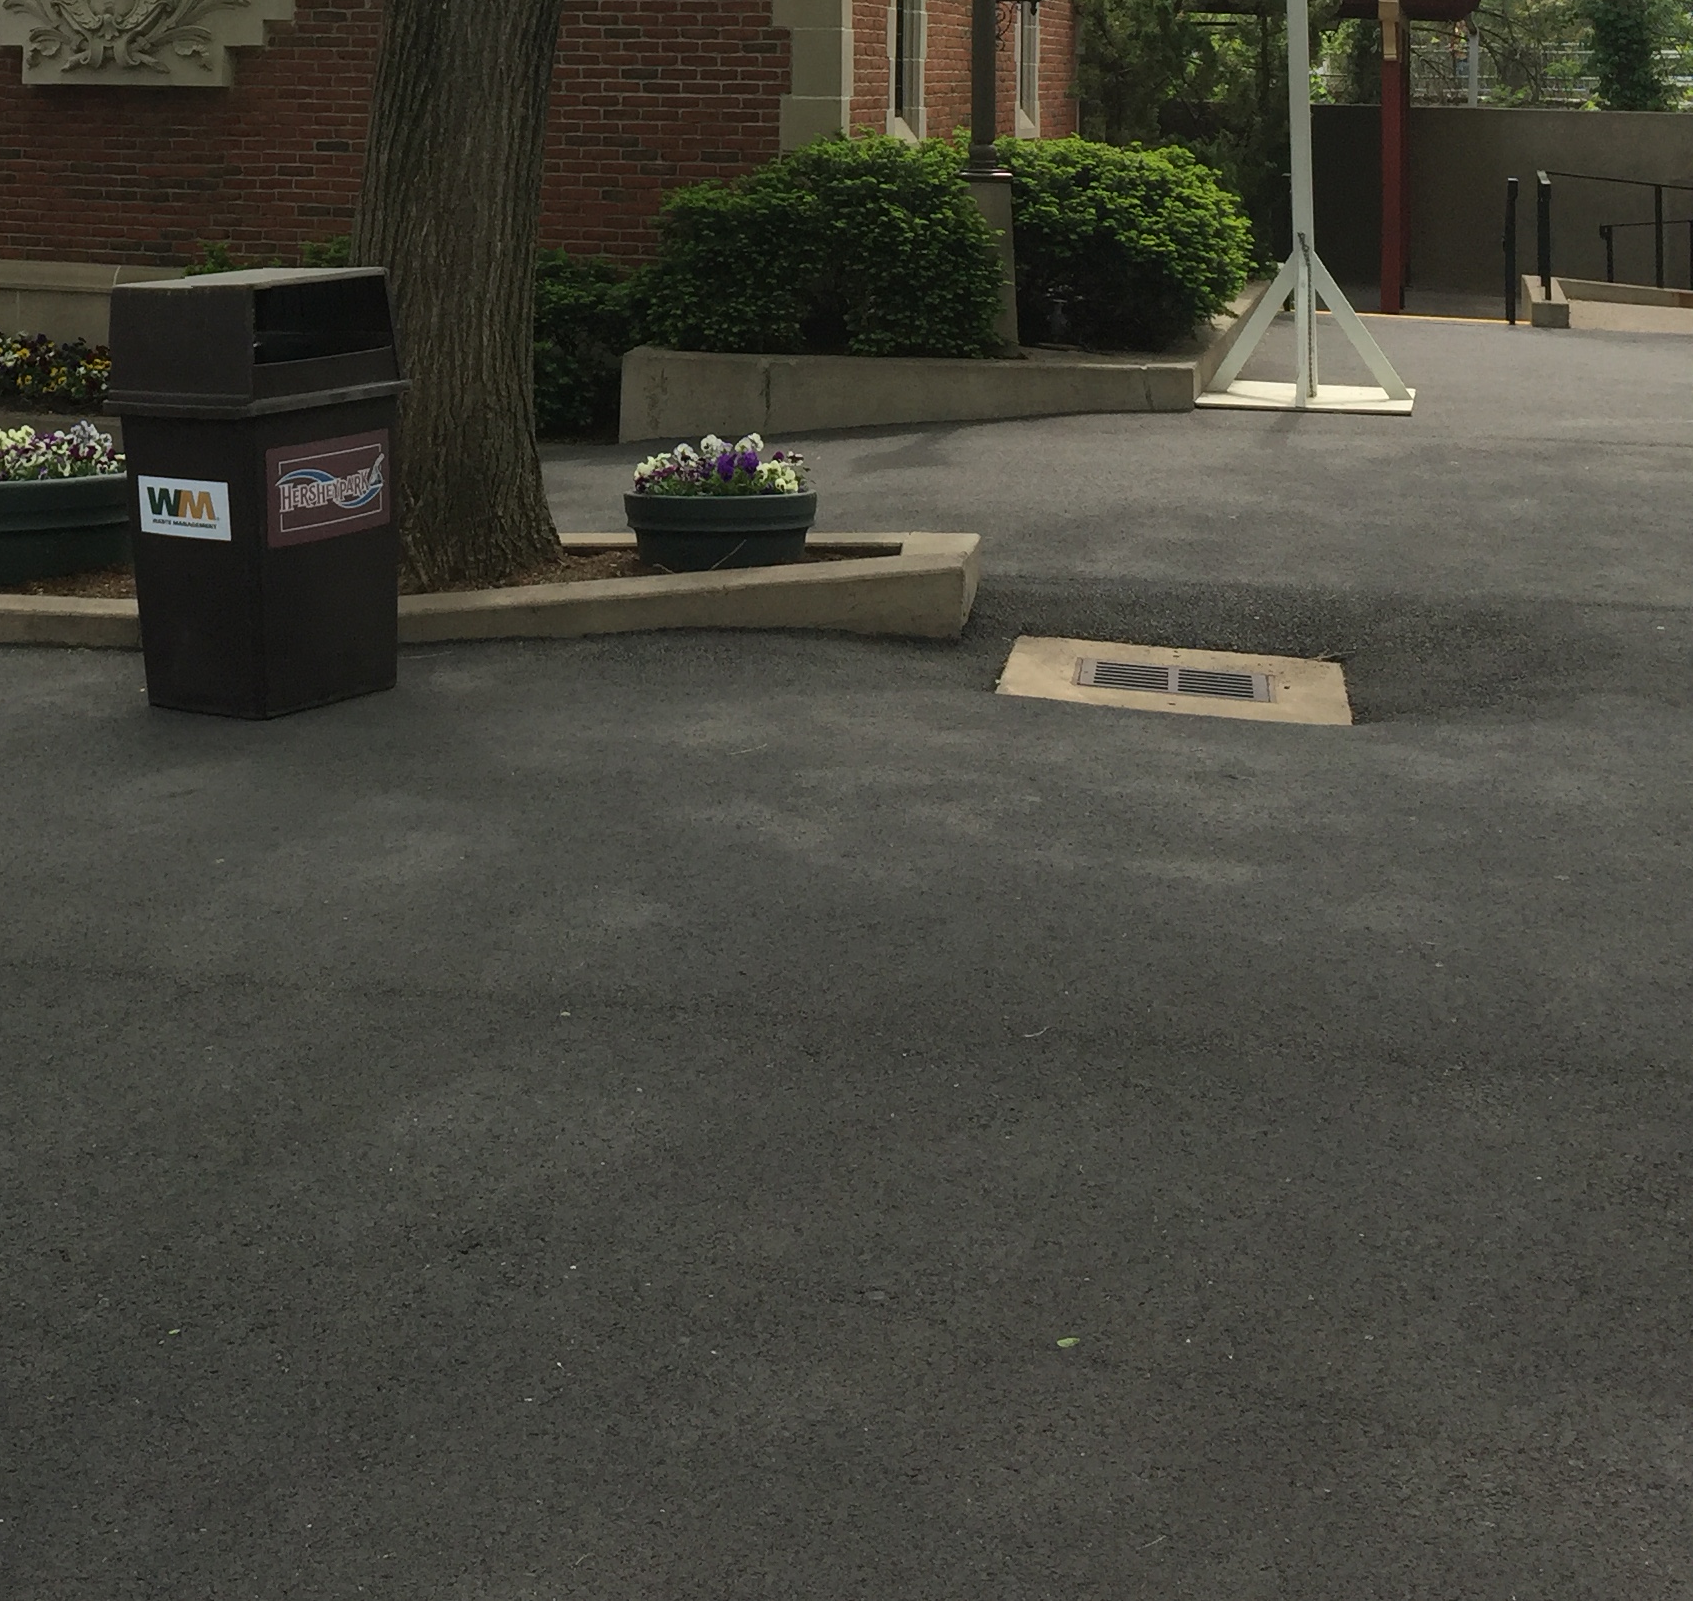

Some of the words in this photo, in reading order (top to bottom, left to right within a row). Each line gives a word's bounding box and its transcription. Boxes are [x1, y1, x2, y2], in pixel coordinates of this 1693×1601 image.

[147, 486, 217, 520] WM
[279, 468, 370, 513] HERSHEYPARK
[173, 520, 217, 530] MANAGEMENT
